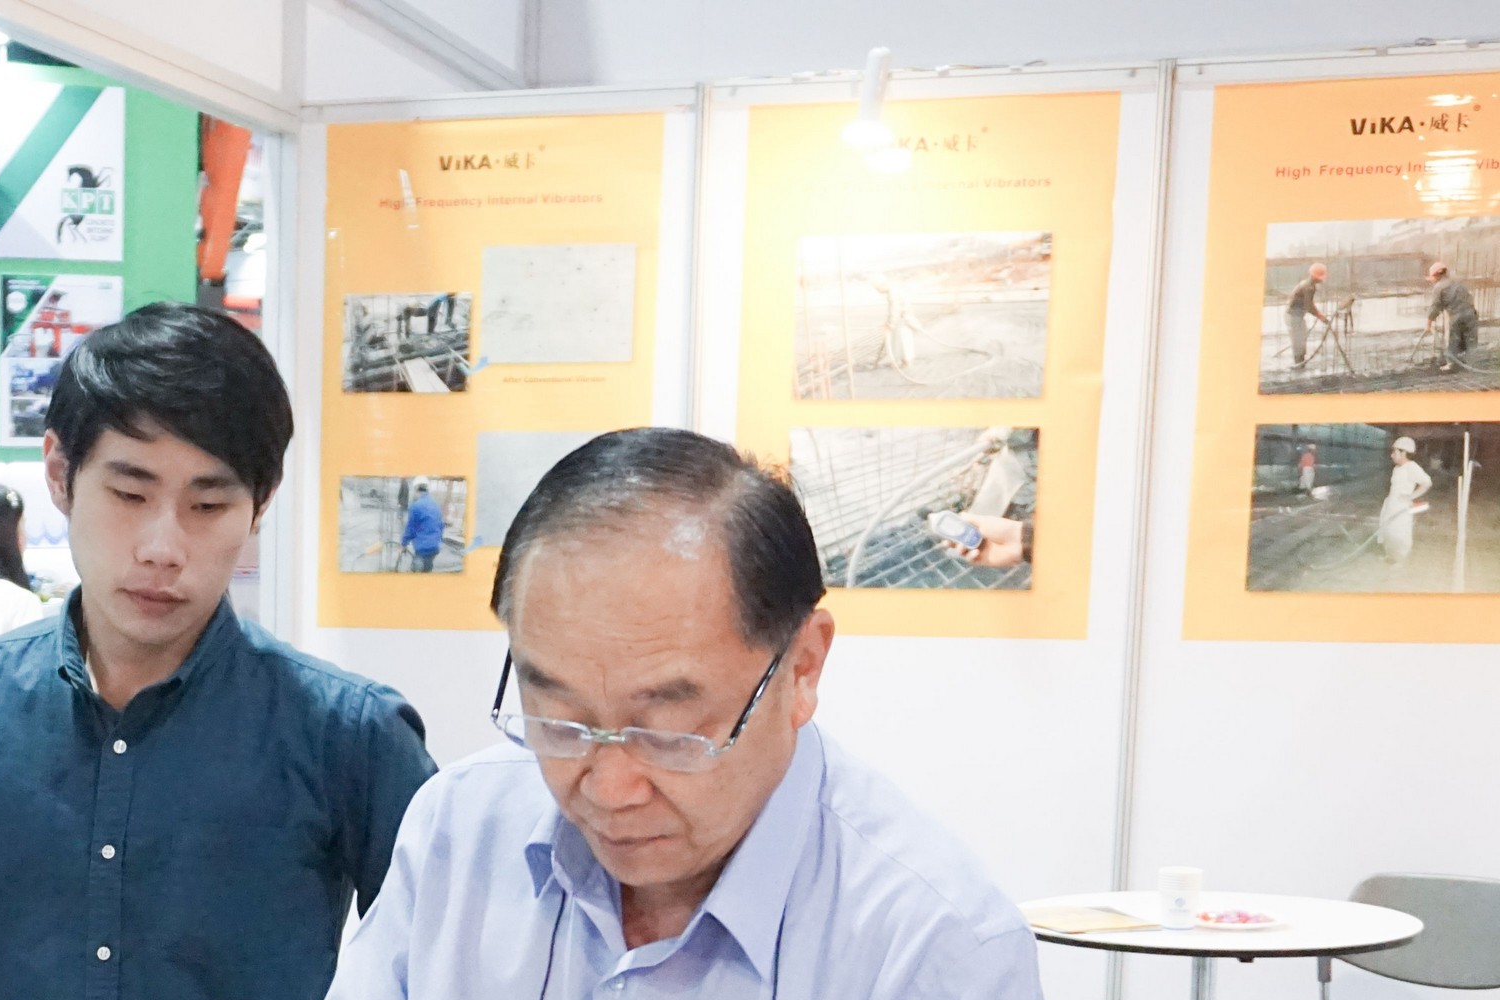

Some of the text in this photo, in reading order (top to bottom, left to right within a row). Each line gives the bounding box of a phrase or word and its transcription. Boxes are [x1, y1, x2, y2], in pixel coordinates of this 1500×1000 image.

[1275, 165, 1311, 180] High
[1319, 162, 1403, 177] Frequency
[984, 176, 1052, 189] Vibrators
[62, 190, 114, 212] KPT
[414, 196, 483, 209] Frequency
[487, 194, 537, 206] Internal
[541, 191, 603, 204] Vibrators
